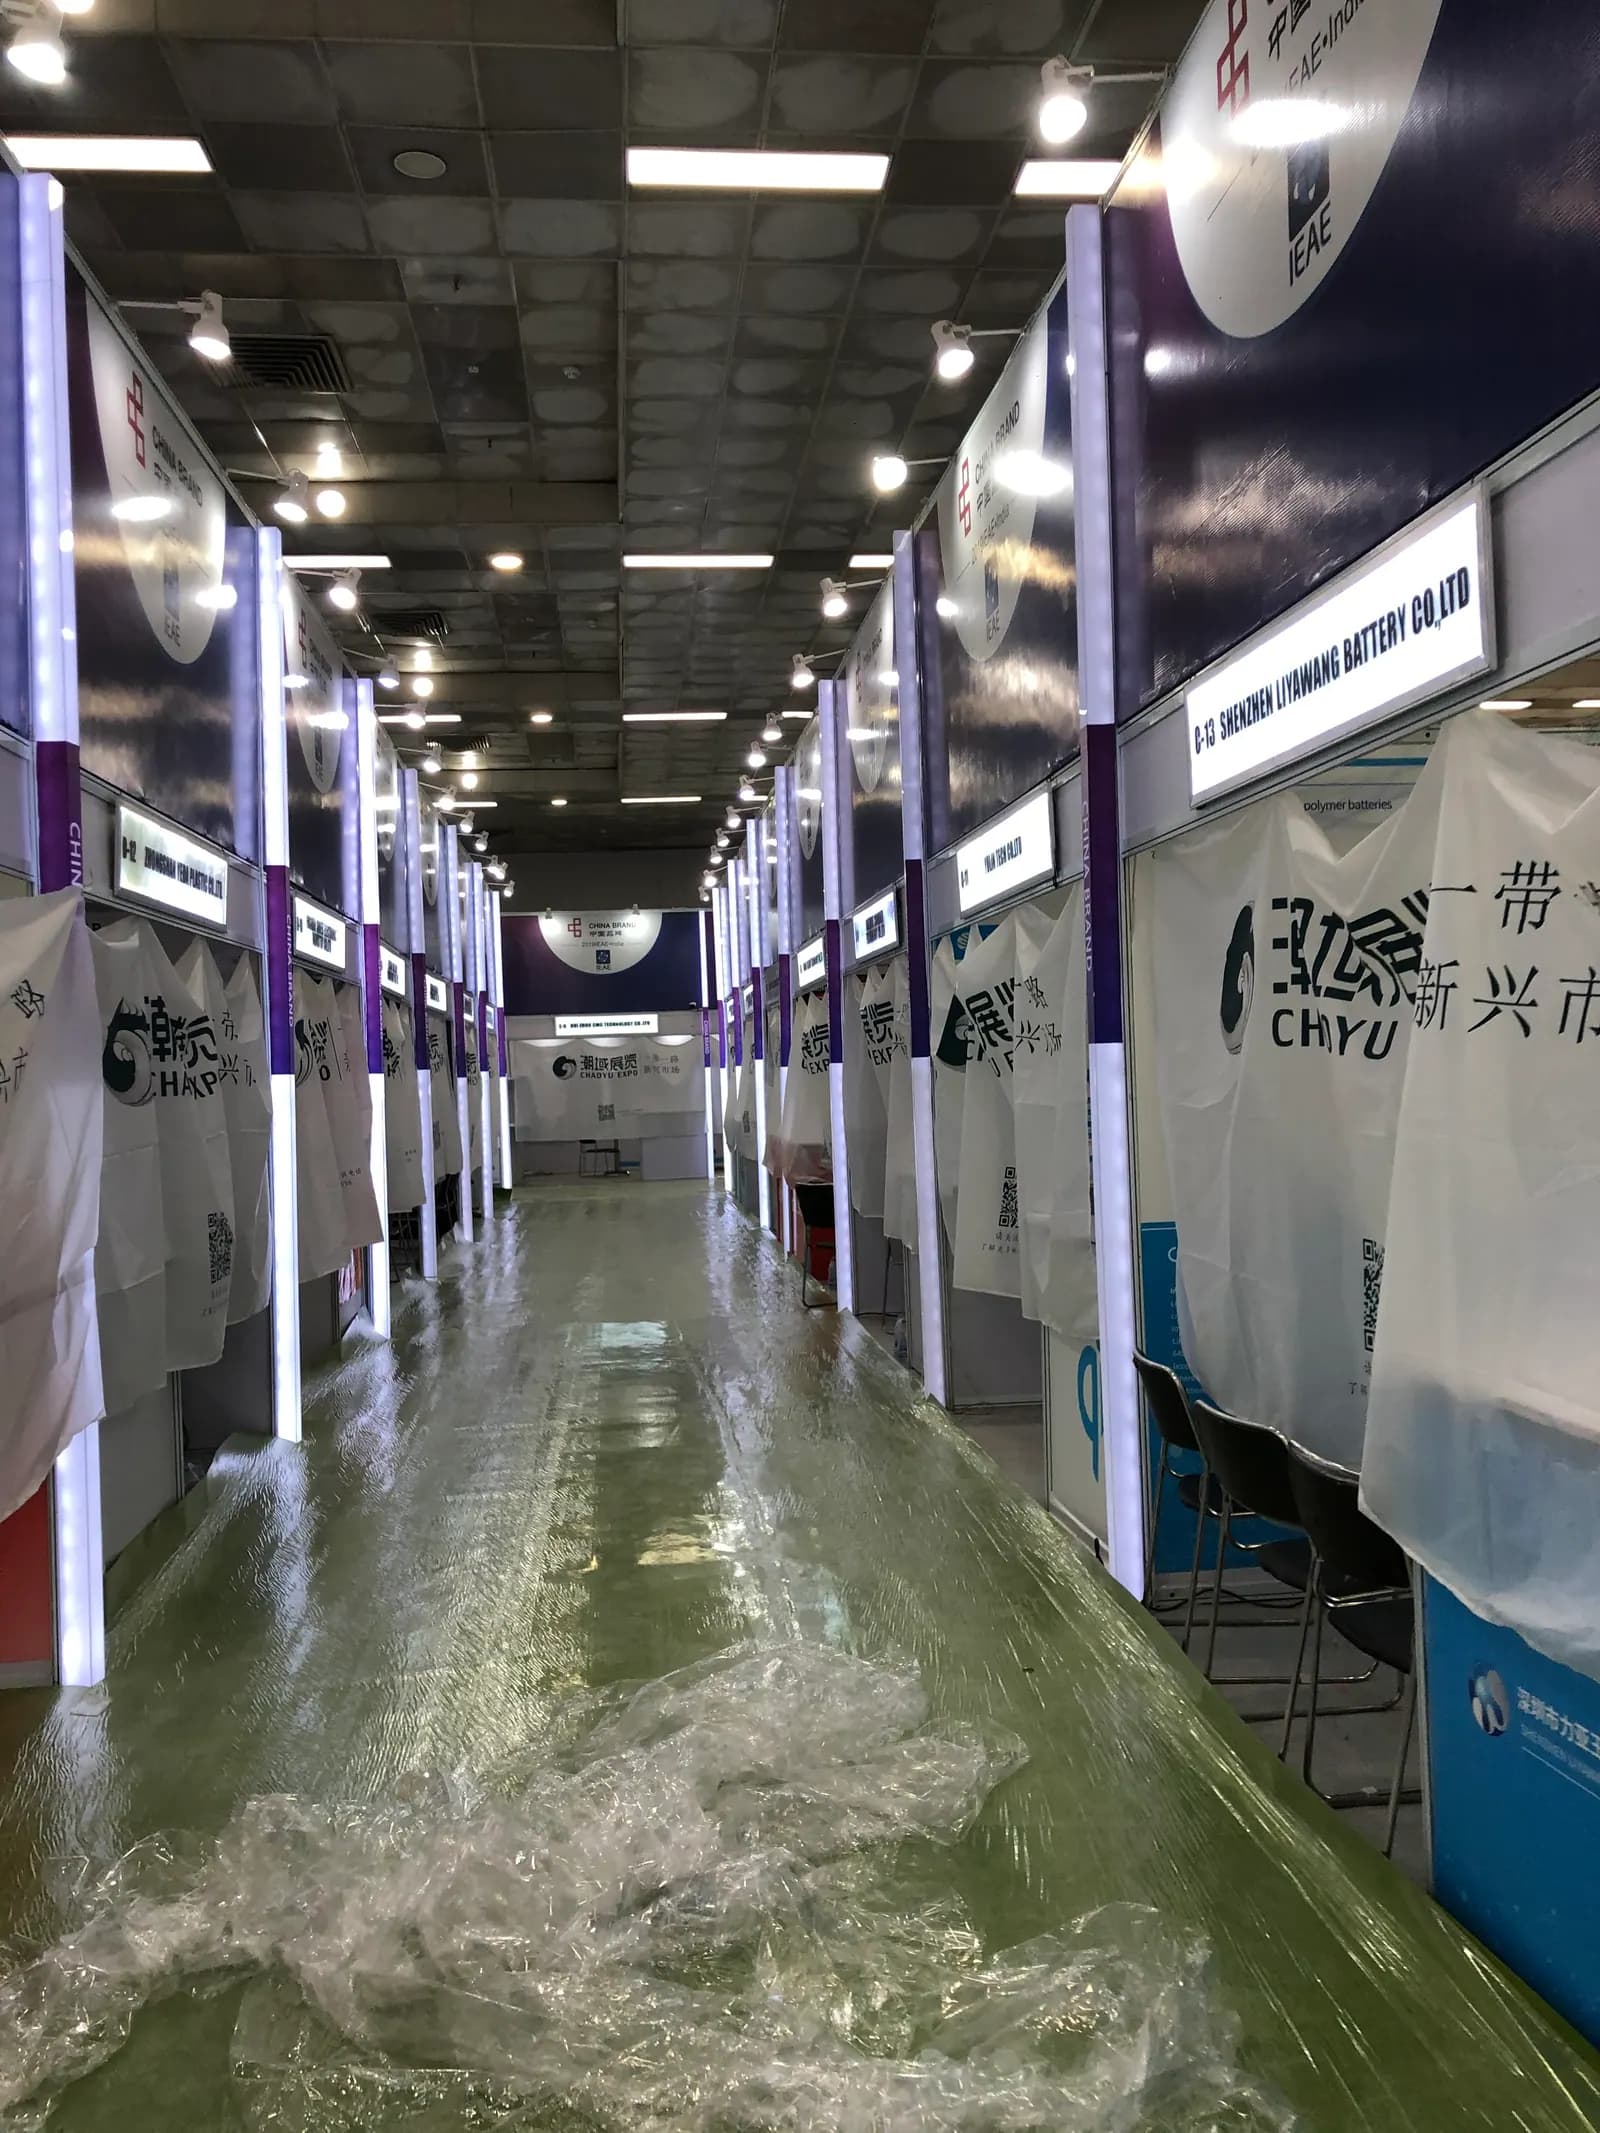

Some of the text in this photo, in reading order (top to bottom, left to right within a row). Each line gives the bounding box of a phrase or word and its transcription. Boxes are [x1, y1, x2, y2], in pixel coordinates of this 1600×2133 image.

[1288, 201, 1333, 287] IEAE
[1194, 718, 1217, 755] C-13
[1219, 684, 1275, 740] SHENZHEN
[1275, 645, 1341, 711] LIYAWANG
[1343, 603, 1407, 675] BATTERY
[1303, 798, 1393, 812] polymer batteries
[70, 822, 83, 887] CHIN
[617, 1069, 639, 1079] EXPO
